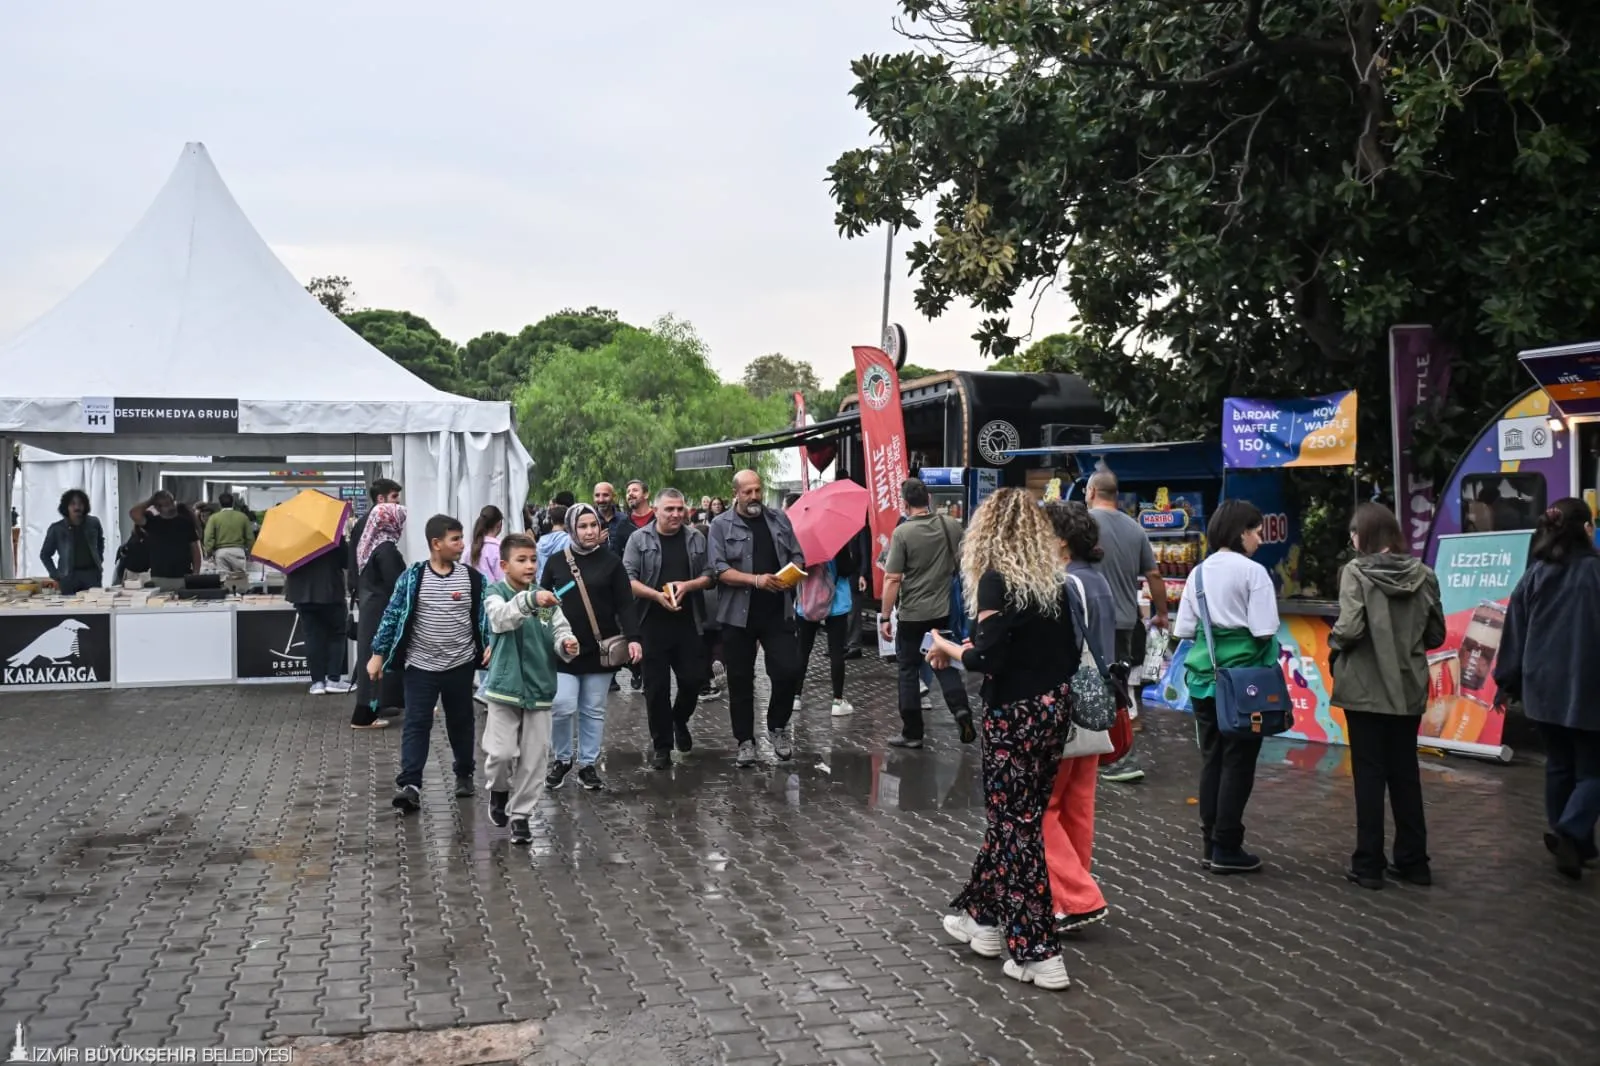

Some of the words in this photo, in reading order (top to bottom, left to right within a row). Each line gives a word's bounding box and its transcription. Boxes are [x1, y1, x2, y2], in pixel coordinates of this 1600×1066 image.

[114, 408, 156, 418] DESTEK
[156, 409, 196, 419] MEDYA
[198, 409, 238, 419] GRUBU
[1233, 409, 1280, 421] BARDAK
[1313, 406, 1343, 418] KOVA
[88, 415, 107, 425] H1
[1304, 418, 1349, 431] WAFFLE
[1233, 423, 1278, 434] WAFFLE
[1238, 438, 1264, 451] 150
[1308, 435, 1337, 449] 250
[1143, 514, 1174, 524] HARIBO
[1261, 513, 1288, 544] IBO
[1450, 548, 1511, 568] LEZZETİN
[1447, 570, 1478, 588] YENİ
[1479, 569, 1511, 588] HALİ
[272, 660, 308, 669] DESTE
[1463, 648, 1482, 681] HYPE
[4, 666, 98, 684] KARAKARGA
